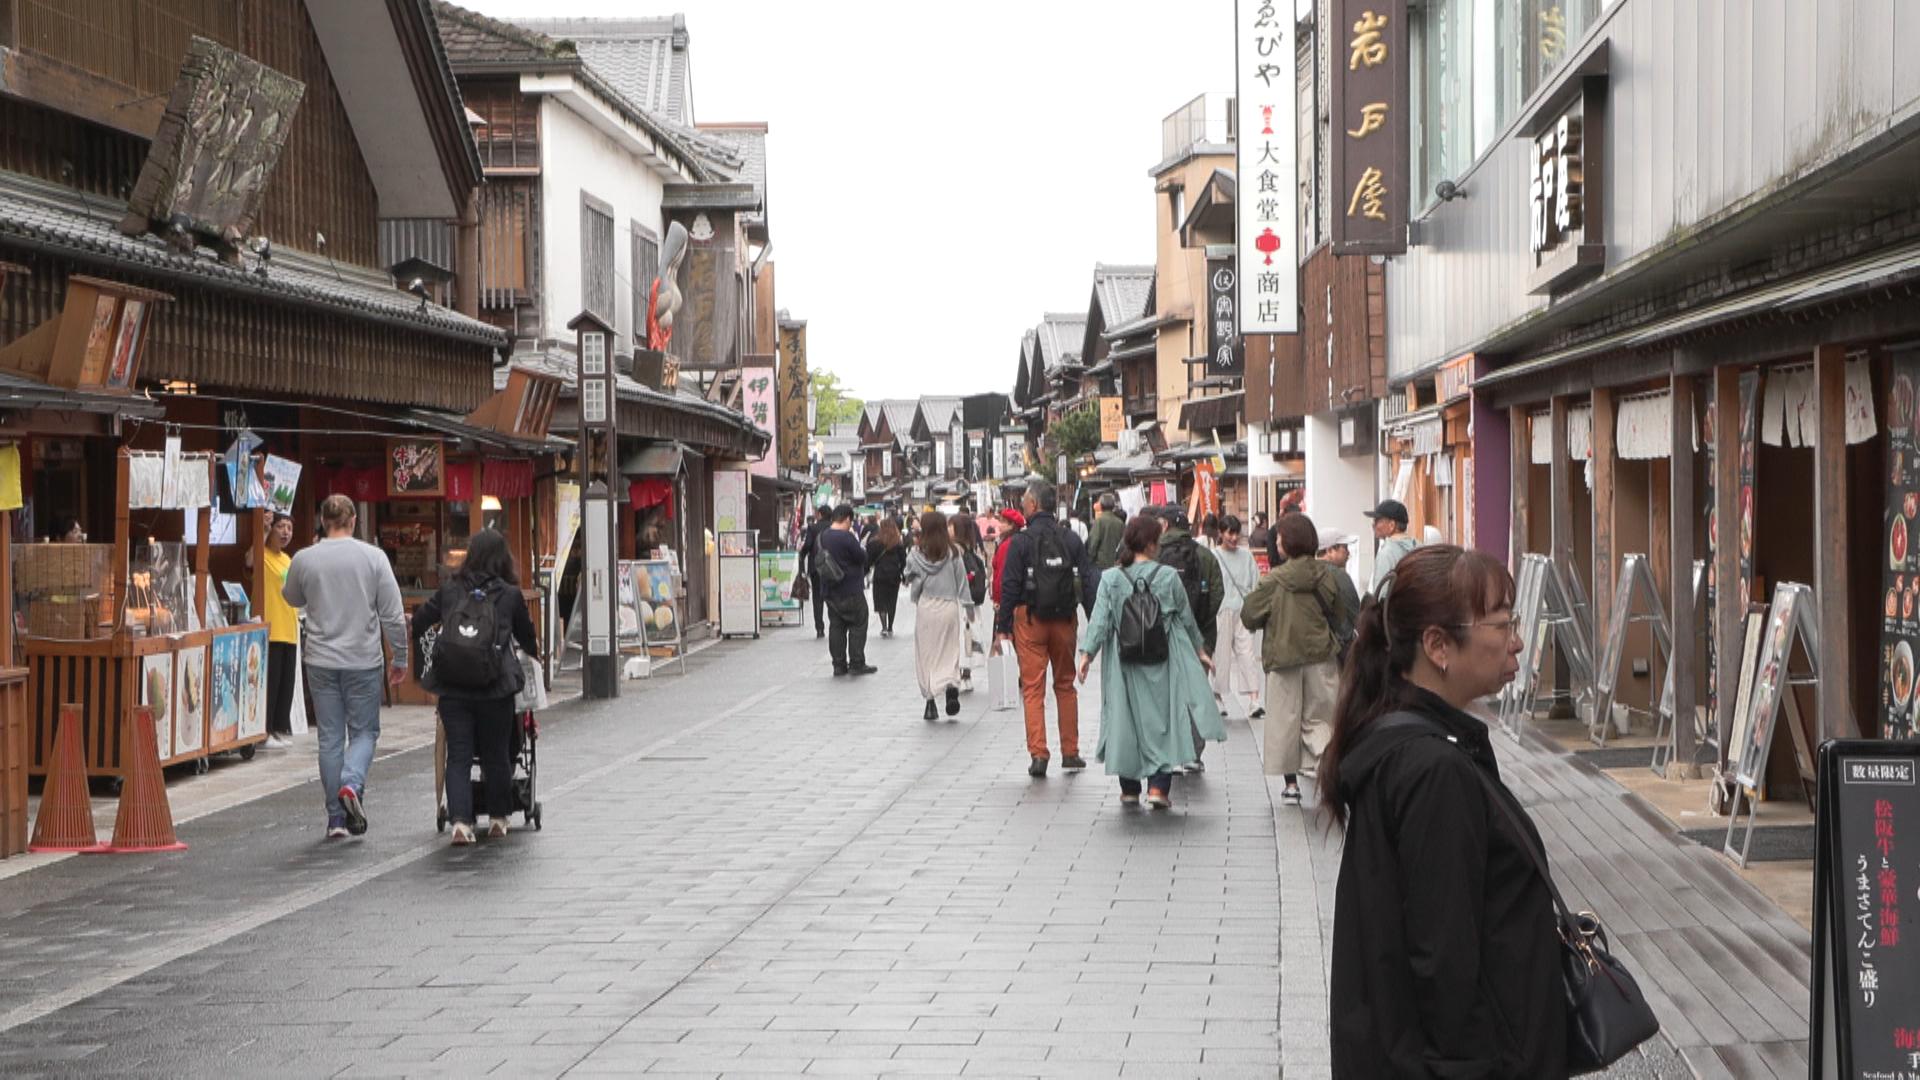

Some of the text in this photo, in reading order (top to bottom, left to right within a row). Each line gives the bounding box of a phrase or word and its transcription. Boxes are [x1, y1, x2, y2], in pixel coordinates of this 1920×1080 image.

[1347, 10, 1389, 221] 岩戸屋
[1256, 140, 1280, 222] 大食堂
[1257, 270, 1280, 323] 商店
[1852, 765, 1909, 780] 数量限定
[1856, 854, 1879, 1008] うまさてんこ盛り
[1893, 1025, 1920, 1050] 海
